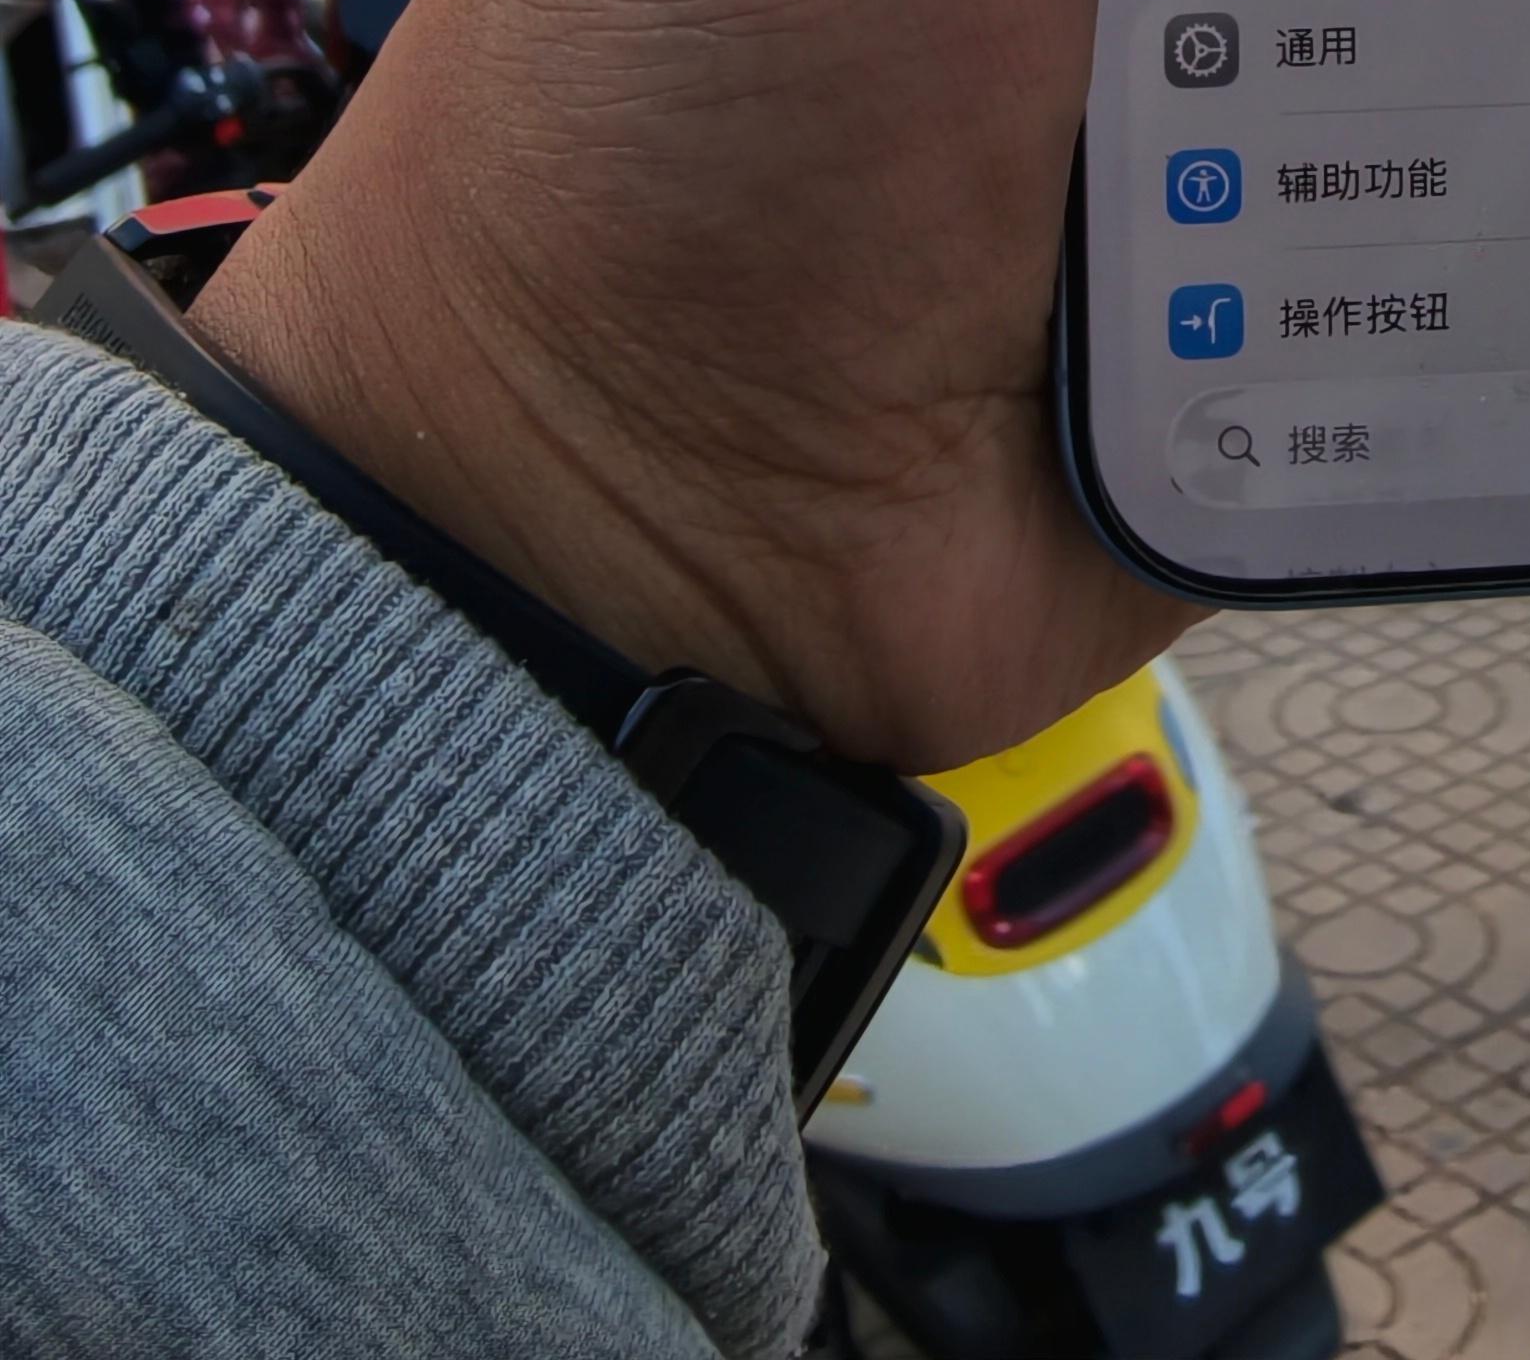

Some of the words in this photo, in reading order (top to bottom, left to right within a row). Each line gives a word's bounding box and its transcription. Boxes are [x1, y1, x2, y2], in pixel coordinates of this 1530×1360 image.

[1275, 26, 1357, 68] 通用
[1277, 157, 1447, 204] 辅助功能
[1279, 292, 1450, 339] 操作按钮
[1287, 422, 1370, 465] 搜索
[1155, 1132, 1300, 1298] 九号
